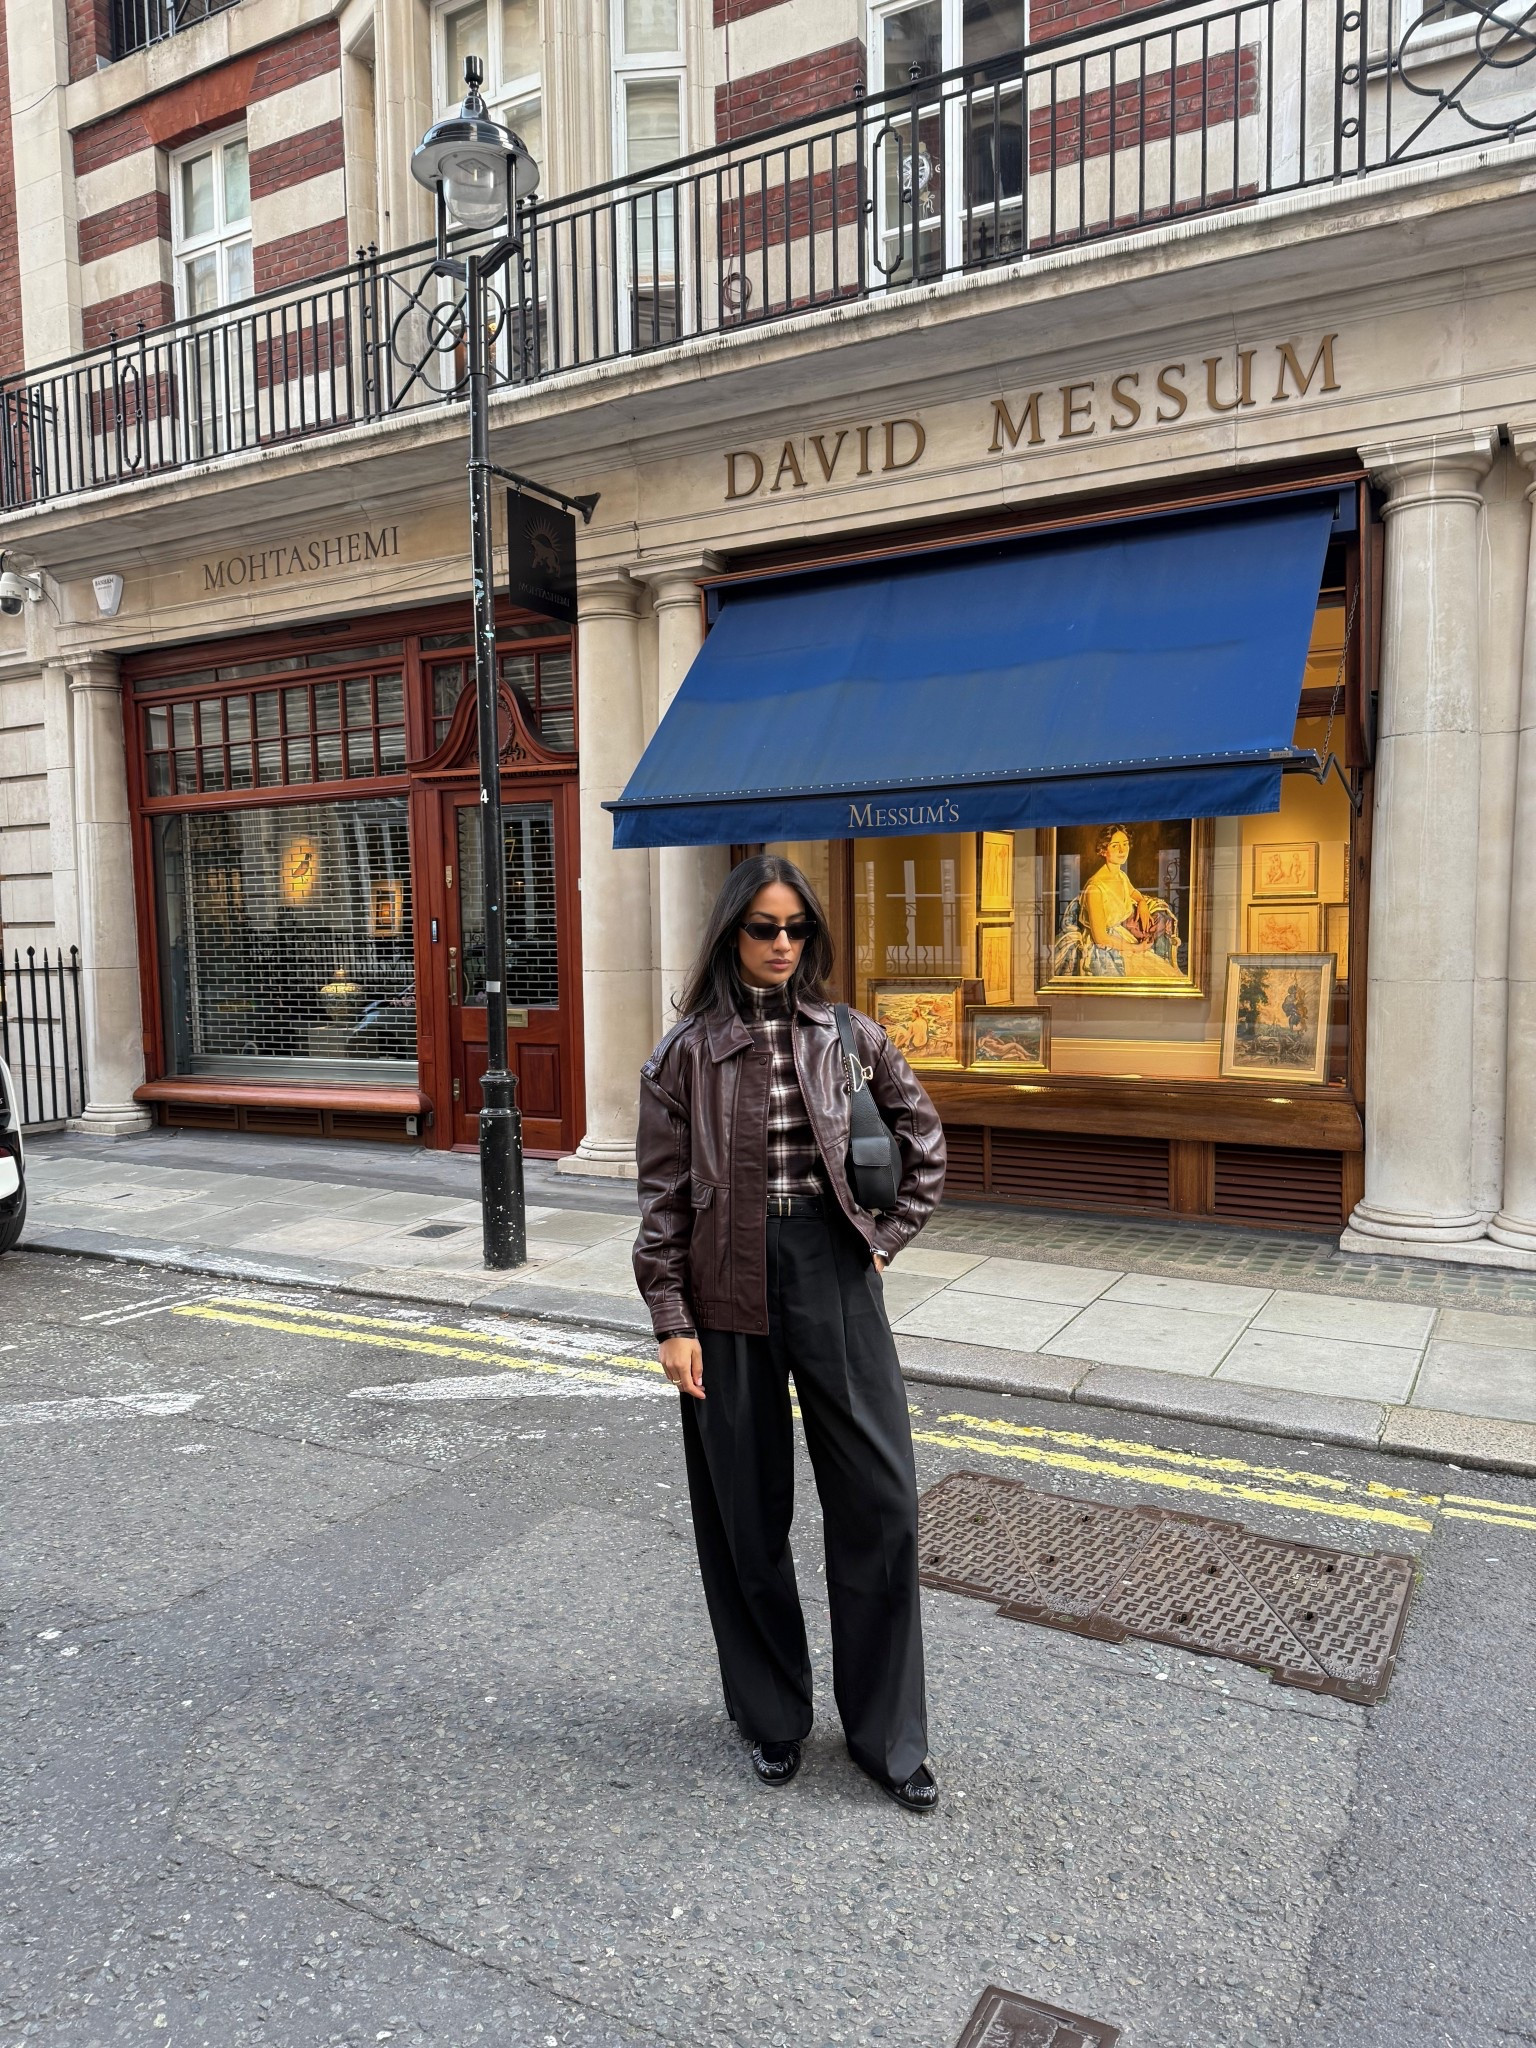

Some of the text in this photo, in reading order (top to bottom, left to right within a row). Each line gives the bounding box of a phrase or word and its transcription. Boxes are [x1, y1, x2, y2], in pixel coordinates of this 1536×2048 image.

[724, 333, 1341, 500] DAVID MESSUM
[203, 526, 400, 590] MOHTASHEMI
